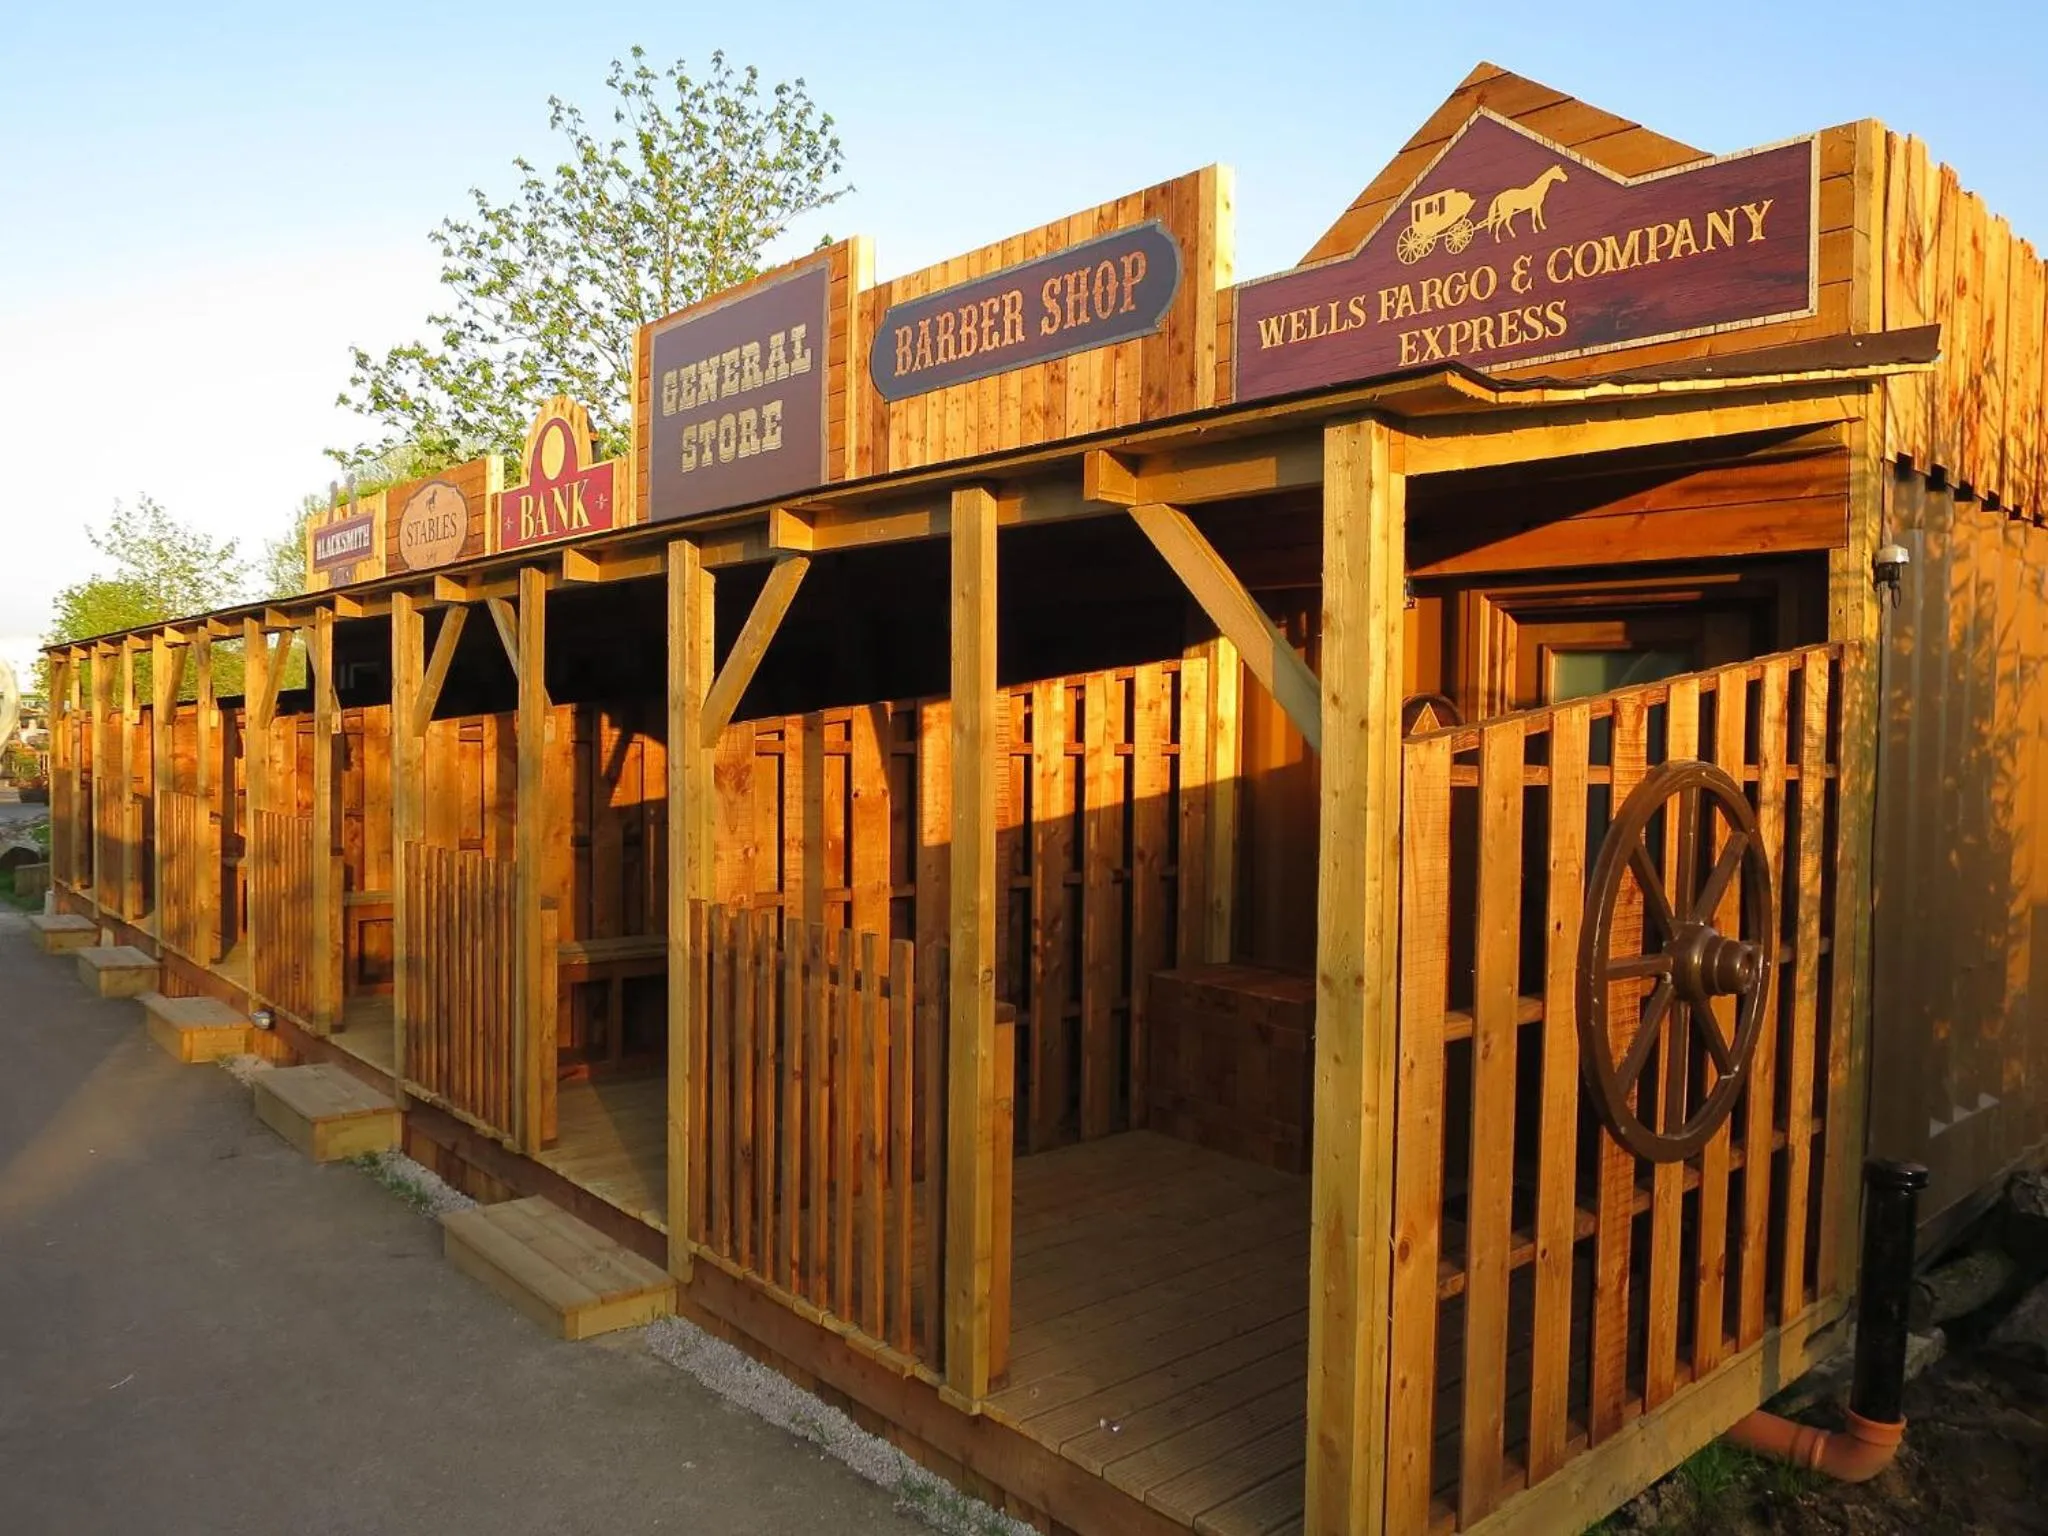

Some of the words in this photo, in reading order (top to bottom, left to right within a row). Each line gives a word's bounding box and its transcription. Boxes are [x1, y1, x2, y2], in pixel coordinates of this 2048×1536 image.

[1258, 294, 1367, 350] WELLS
[1377, 265, 1498, 325] FARGO
[1511, 254, 1534, 294] &
[1546, 199, 1774, 285] COMPANY
[894, 289, 1026, 377] BARBER
[1040, 250, 1147, 337] SHOP
[1398, 300, 1568, 368] EXPRESS
[662, 323, 812, 416] GENERAL
[681, 400, 784, 473] STORE
[405, 512, 458, 547] STABLES
[519, 479, 590, 541] BANK
